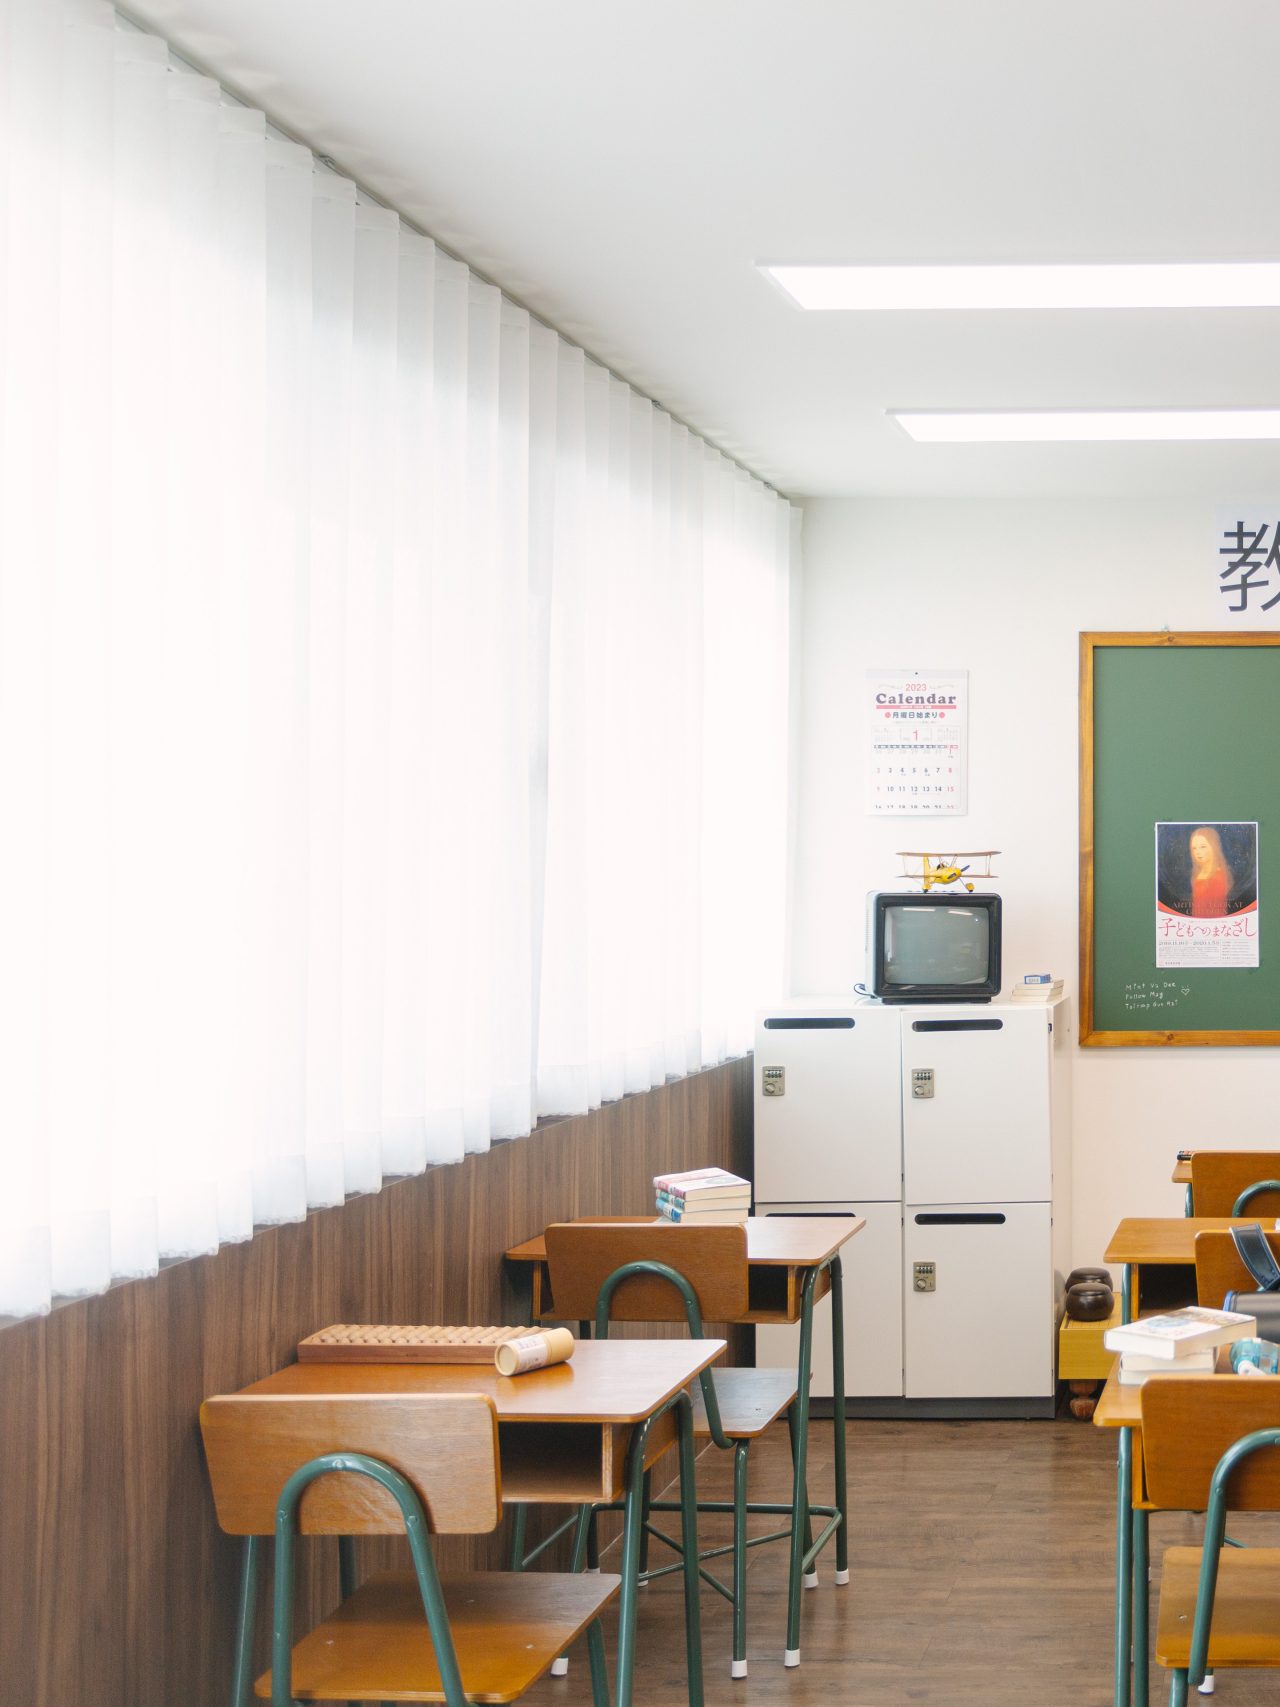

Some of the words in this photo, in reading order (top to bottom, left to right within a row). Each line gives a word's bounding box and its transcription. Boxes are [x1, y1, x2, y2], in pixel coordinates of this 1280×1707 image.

[905, 683, 927, 692] 2023
[875, 693, 957, 705] Calendar
[892, 711, 938, 719] 月曜日始まり
[912, 729, 919, 741] 1
[1159, 917, 1257, 938] 子どもへのまなざし
